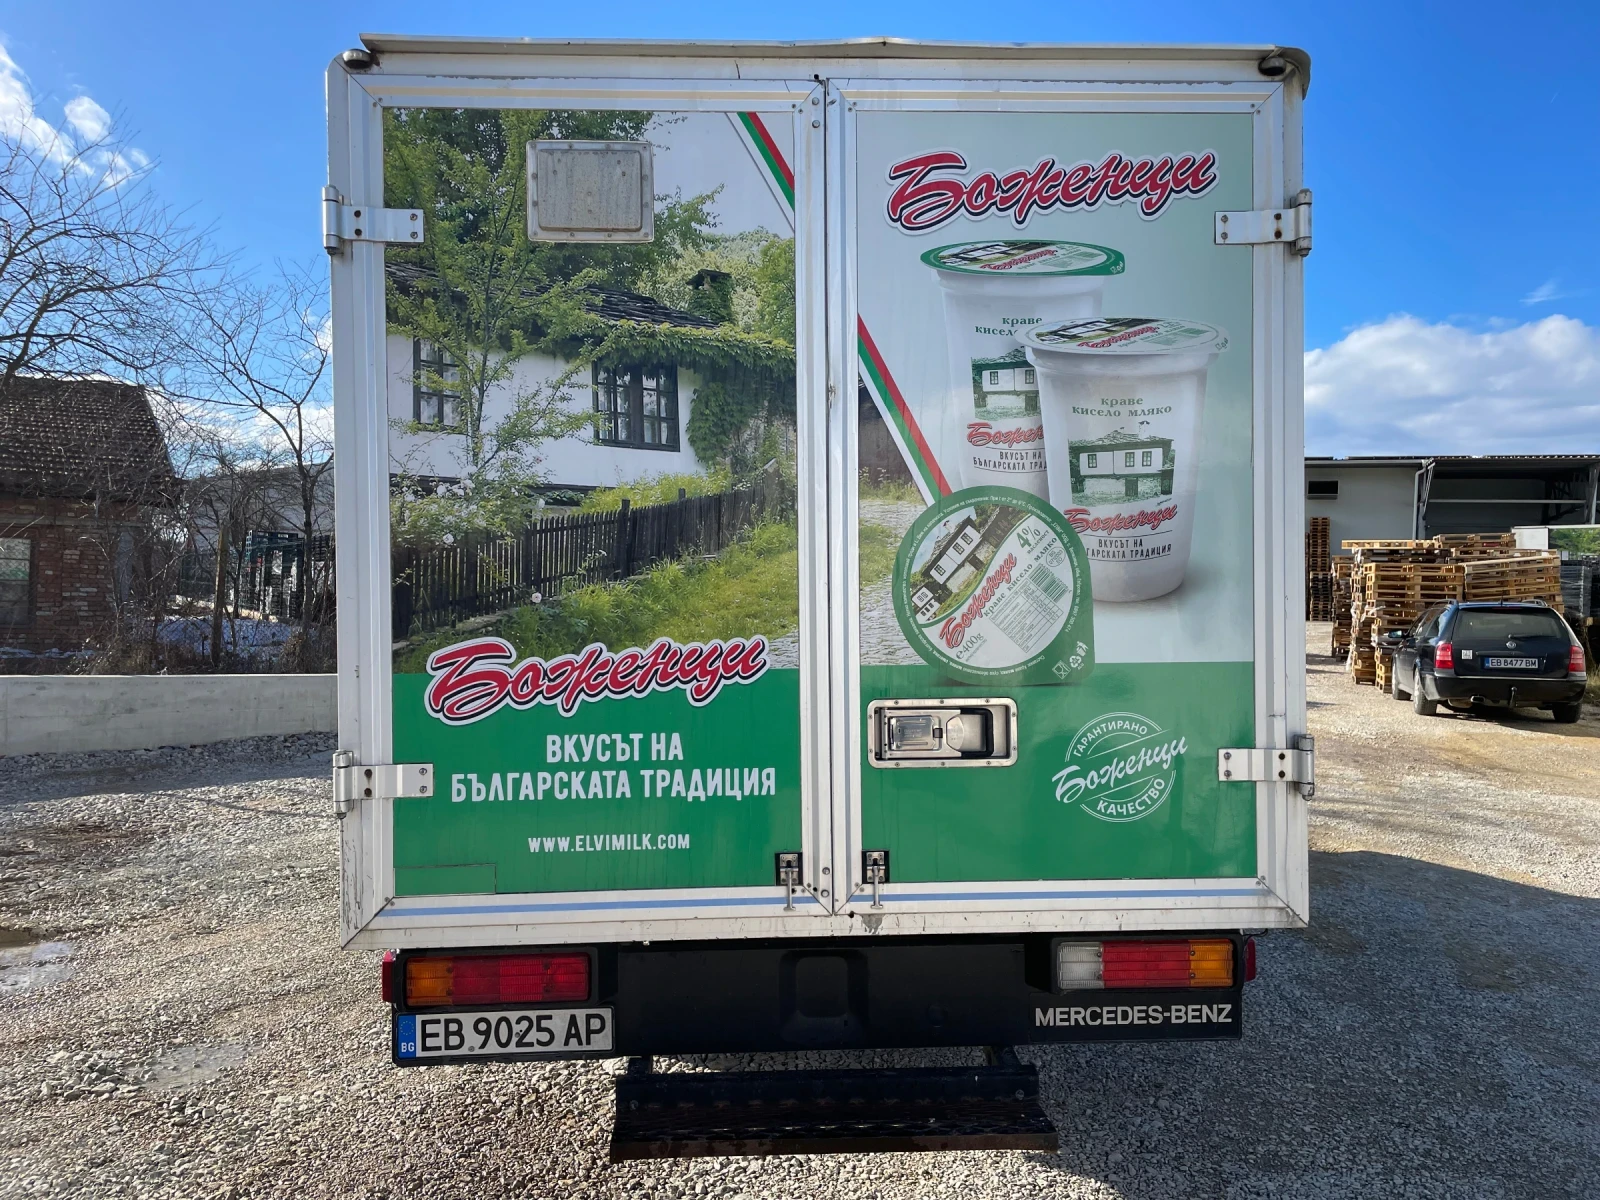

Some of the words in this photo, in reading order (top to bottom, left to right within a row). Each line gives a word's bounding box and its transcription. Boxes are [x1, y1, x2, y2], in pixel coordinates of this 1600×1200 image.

[886, 150, 1218, 231] Боженци
[1002, 317, 1042, 327] краве
[1072, 406, 1121, 417] кисело
[1128, 405, 1172, 417] мляко
[1101, 397, 1143, 407] краве
[973, 457, 1026, 470] БЪЛГАРСКАТА
[1000, 451, 1028, 460] ВКУСЪТ
[1032, 451, 1042, 460] НА
[1064, 504, 1178, 535] Боженци
[1086, 548, 1126, 559] ГАРСКАТА
[1130, 543, 1172, 558] ТРАДИЦИЯ
[1099, 539, 1129, 549] ВКУСЪТ
[1133, 538, 1143, 547] НА
[939, 552, 1017, 649] Боженци
[1491, 659, 1502, 667] EB
[426, 637, 767, 722] Боженци
[546, 734, 643, 763] ВКУСЪТ
[651, 733, 683, 761] НА
[1073, 720, 1147, 757] ГАРАНТИРАНО
[1052, 736, 1188, 803] Боженци
[451, 770, 631, 802] БЪЛГАРСКАТА
[641, 767, 775, 802] ТРАДИЦИЯ
[1097, 778, 1165, 816] КАЧЕСТВО
[528, 834, 690, 852] WWW.ELVIMILK.COM
[1035, 1004, 1232, 1027] MERCEDES-BENZ
[421, 1018, 465, 1052] EB
[473, 1015, 555, 1050] 9025
[564, 1013, 606, 1047] AP
[401, 1043, 414, 1052] BG
